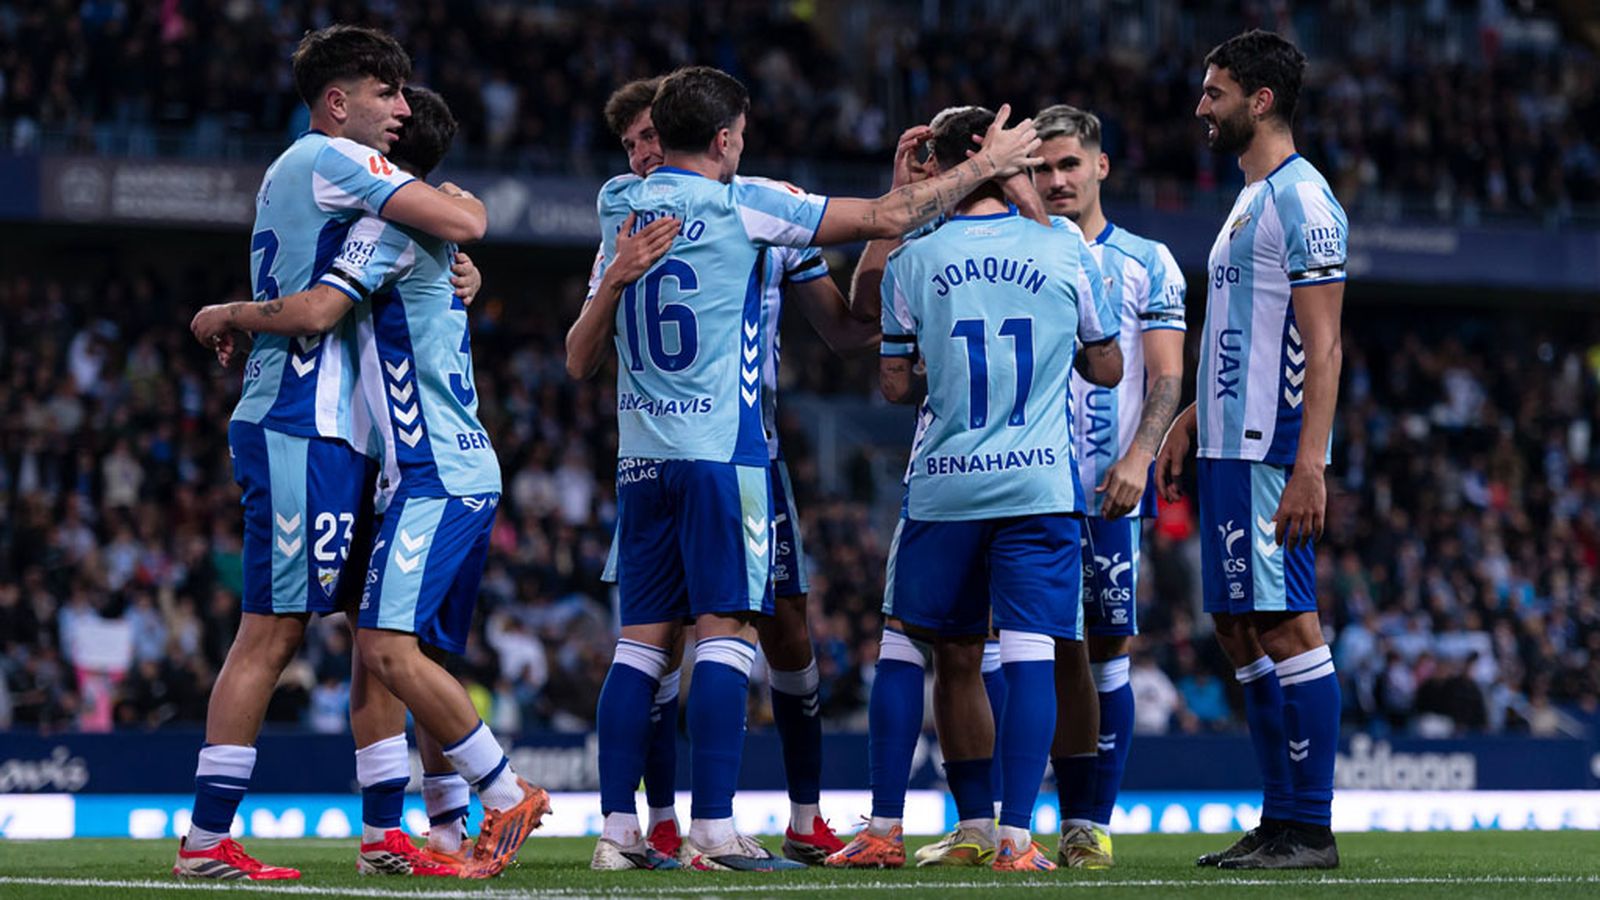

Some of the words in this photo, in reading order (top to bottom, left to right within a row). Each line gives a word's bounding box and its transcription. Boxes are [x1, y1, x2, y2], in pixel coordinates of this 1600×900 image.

[931, 257, 1048, 297] JOAQUÍN
[623, 258, 699, 372] 16
[950, 317, 1033, 430] 11
[1217, 328, 1243, 400] UAX
[1085, 389, 1112, 459] UAX
[926, 447, 1056, 476] BENAHAVIS
[314, 511, 354, 561] 23
